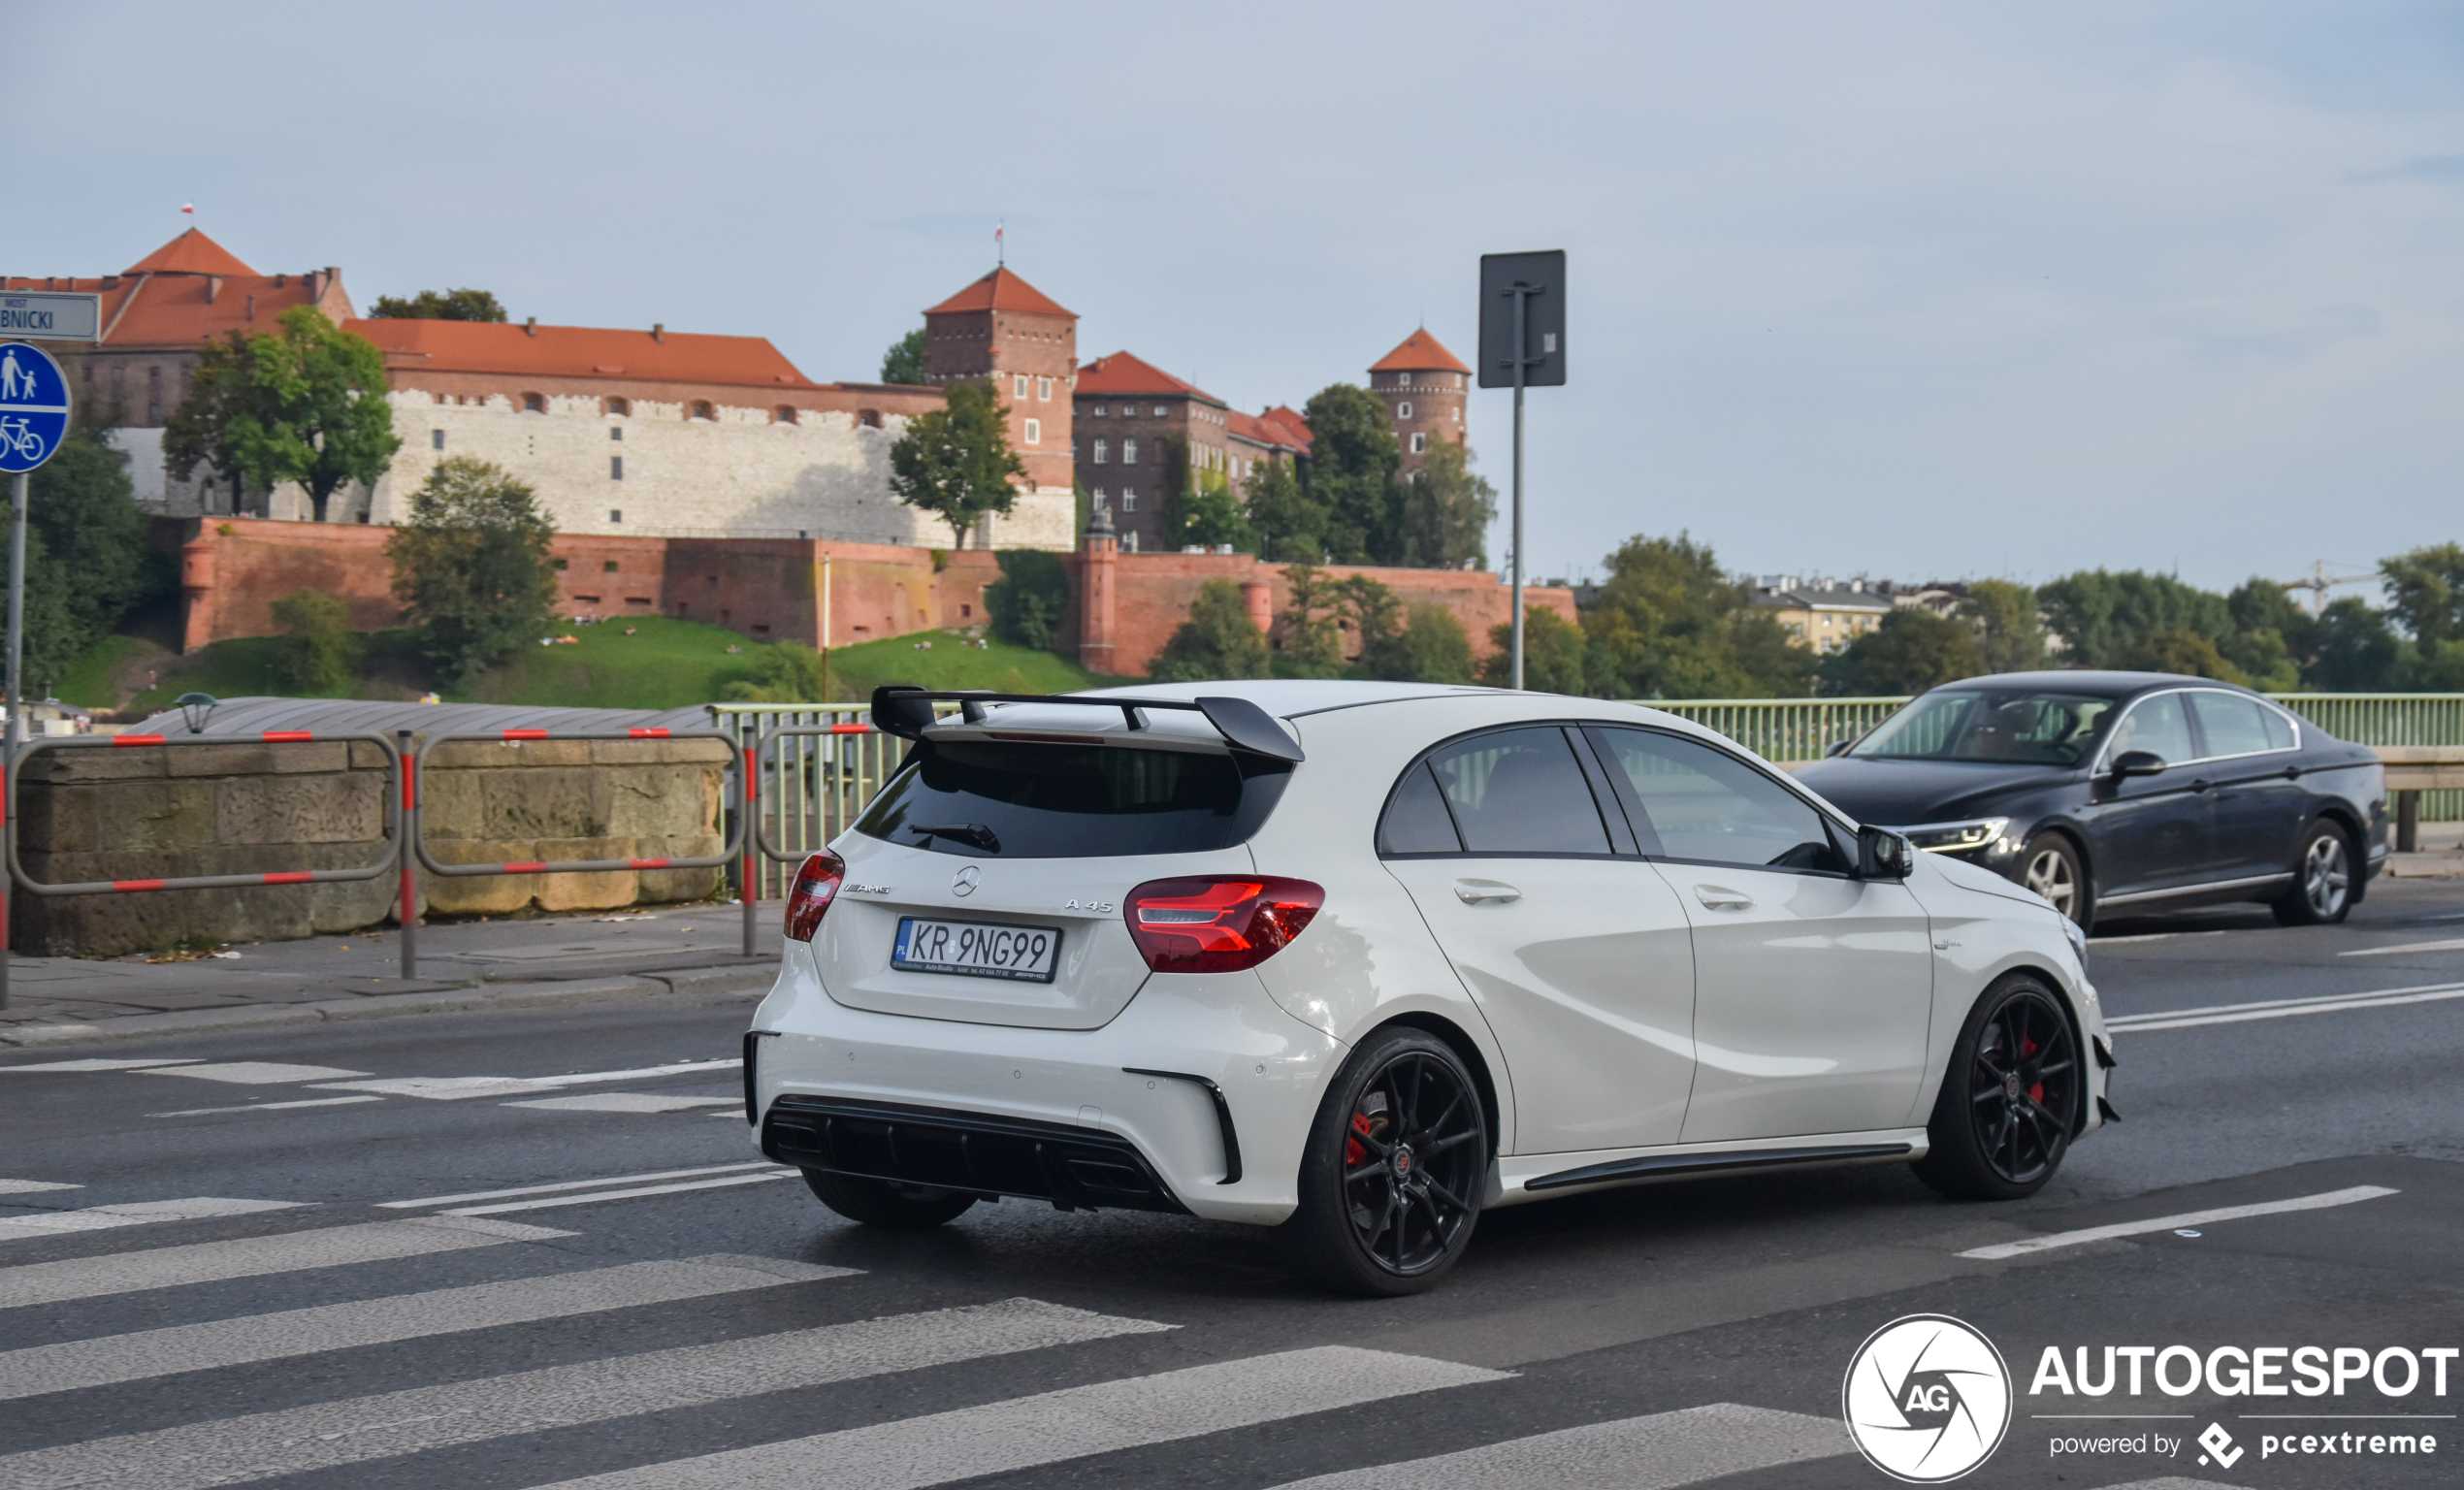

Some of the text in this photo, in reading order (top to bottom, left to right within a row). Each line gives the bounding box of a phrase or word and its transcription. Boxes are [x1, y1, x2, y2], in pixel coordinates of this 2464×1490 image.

[5, 299, 27, 308] MOST
[0, 309, 53, 329] BNICKI
[854, 884, 891, 893] AMG
[1065, 898, 1113, 913] A 45
[896, 945, 906, 956] PL
[912, 923, 1047, 969] KR 9NG99
[924, 963, 954, 972] Auto-Studio
